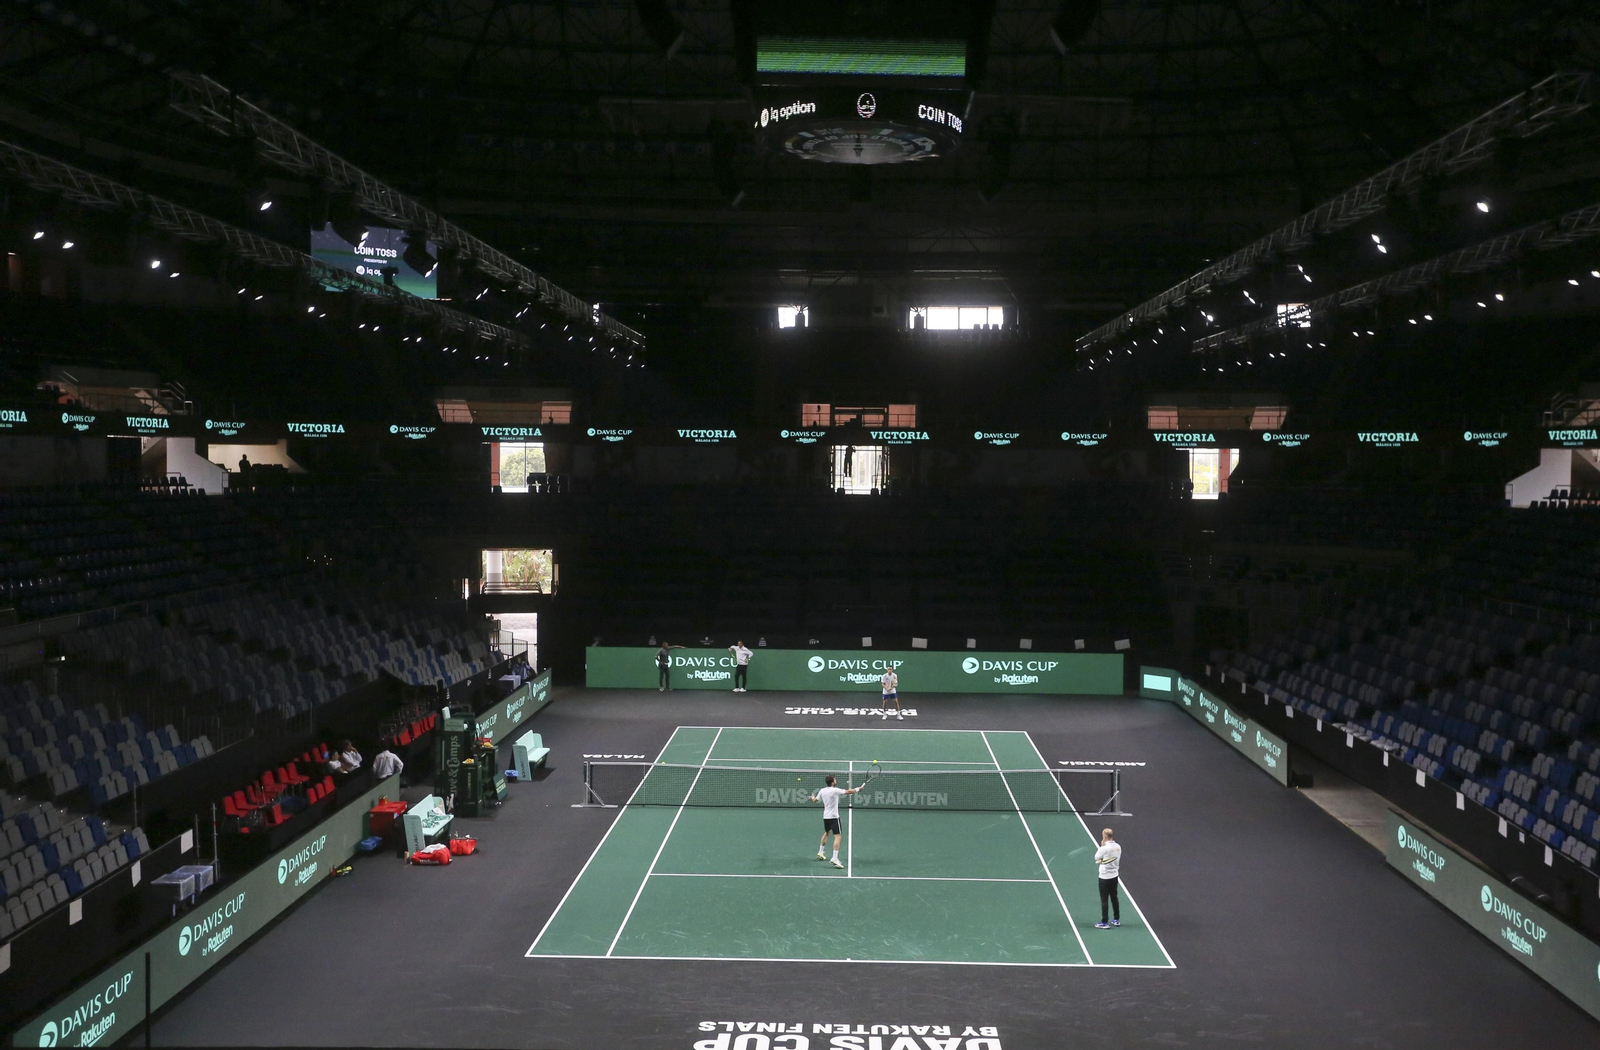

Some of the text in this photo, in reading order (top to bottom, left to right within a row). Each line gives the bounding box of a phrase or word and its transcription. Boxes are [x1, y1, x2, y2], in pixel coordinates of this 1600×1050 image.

[779, 101, 816, 120] option
[918, 104, 946, 125] COIN
[354, 246, 397, 258] COIN TOSS
[366, 267, 374, 276] iq
[0, 410, 28, 422] ORIA
[126, 417, 169, 428] VICTORIA
[287, 423, 345, 433] VICTORIA
[482, 427, 542, 436] VICTORIA
[678, 429, 737, 438] VICTORIA
[870, 431, 929, 440] VICTORIA
[1154, 433, 1216, 442] VICTORIA
[1358, 432, 1419, 442] VICTORIA
[1548, 429, 1598, 440] VICTORIA
[676, 656, 738, 668] DAVIS CU
[828, 660, 902, 670] DAVIS CUP
[983, 661, 1057, 671] DAVIS CUP
[694, 670, 730, 681] Rakuten
[847, 673, 883, 683] Rakuten
[1002, 674, 1038, 685] Rakuten
[447, 736, 460, 767] Camps
[1273, 744, 1281, 758] CUP
[755, 788, 808, 803] DAVIS
[852, 792, 872, 806] by
[874, 792, 947, 805] RAKUTEN
[289, 835, 326, 873] DAVIS CUP
[1407, 834, 1445, 870] DAVIS CUP
[299, 862, 317, 884] Rakuten
[194, 893, 244, 941] DAVIS CUP
[1494, 897, 1546, 943] DAVIS CUP
[208, 925, 233, 952] Rakuten
[1507, 927, 1533, 956] Rakuten
[61, 972, 132, 1039] DAVIS CUP
[81, 1012, 115, 1047] Rakuten
[698, 1020, 999, 1037] BY RAKUTEN FINALS
